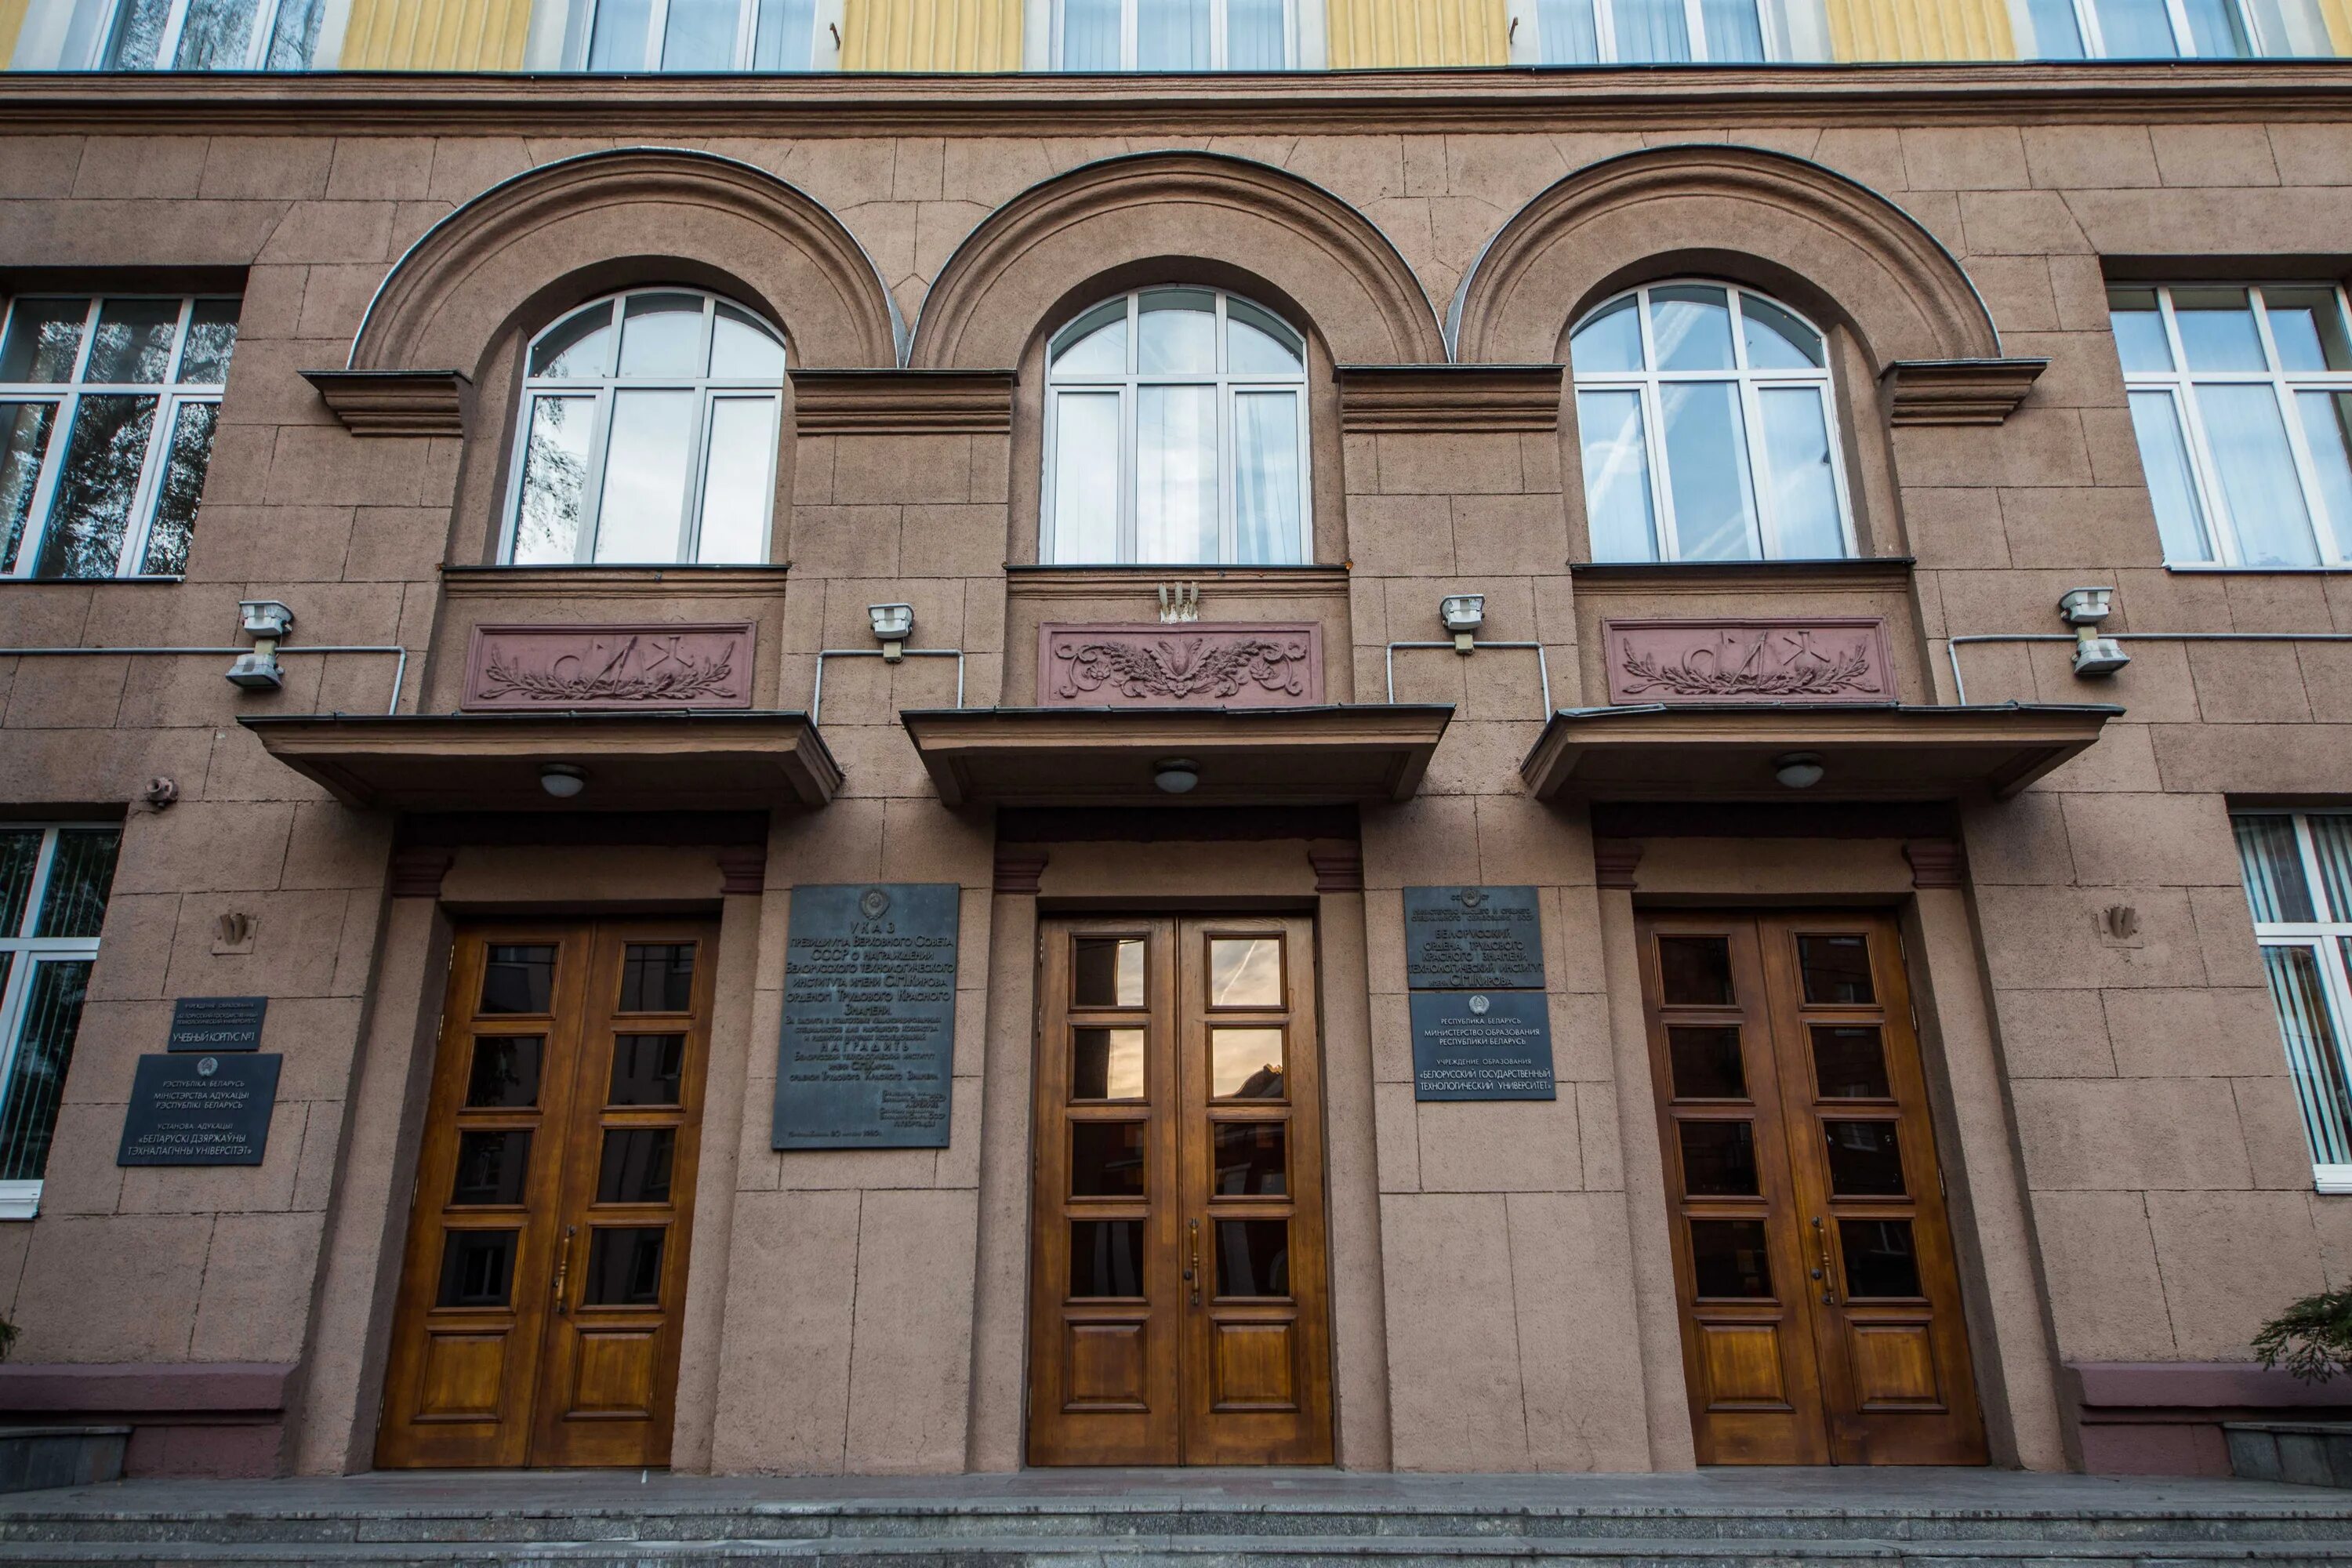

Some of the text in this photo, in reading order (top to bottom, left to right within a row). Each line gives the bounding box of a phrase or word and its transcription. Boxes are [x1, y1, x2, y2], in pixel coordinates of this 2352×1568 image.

[851, 922, 895, 934] УКАЗ
[1436, 928, 1512, 939] БЕЛОРУССКИЙ
[853, 935, 913, 947] ВЕРХОВНОГО
[916, 935, 953, 947] СОВЕТА
[1424, 942, 1524, 952] ОРДЕНА ТРУДОВОГО
[811, 949, 935, 961] СССР О НАГРАЖДЕНИИ
[1423, 952, 1527, 961] КРАСНОГО ЗНАМЕНИ
[786, 963, 955, 974] БЕЛОРУССКОГО ТЕХНОЛОГИЧЕСКОГО
[1409, 963, 1544, 974] ТЕХНОЛОГИЧЕСКИЙ ИНСТИТУТ
[793, 978, 848, 988] ИНСТИТУТА
[837, 991, 892, 1002] ТРУДОВОГО
[898, 991, 950, 1001] КРАСНОГО
[173, 1031, 209, 1042] УЧЕБНЫЙ
[209, 1033, 239, 1041] КОРПУС
[1420, 1068, 1551, 1080] «БЕЛОРУССКИЙ ГОСУДАРСТВЕННЫЙ
[1421, 1080, 1493, 1091] ТЕХНОЛОГИЧЕСКИЙ
[209, 1091, 249, 1101] АДУКАЦЫІ
[191, 1134, 246, 1145] ДЗЯРЖАЎНЫ
[129, 1147, 193, 1156] ТЭХНАЛАГІЧНЫ
